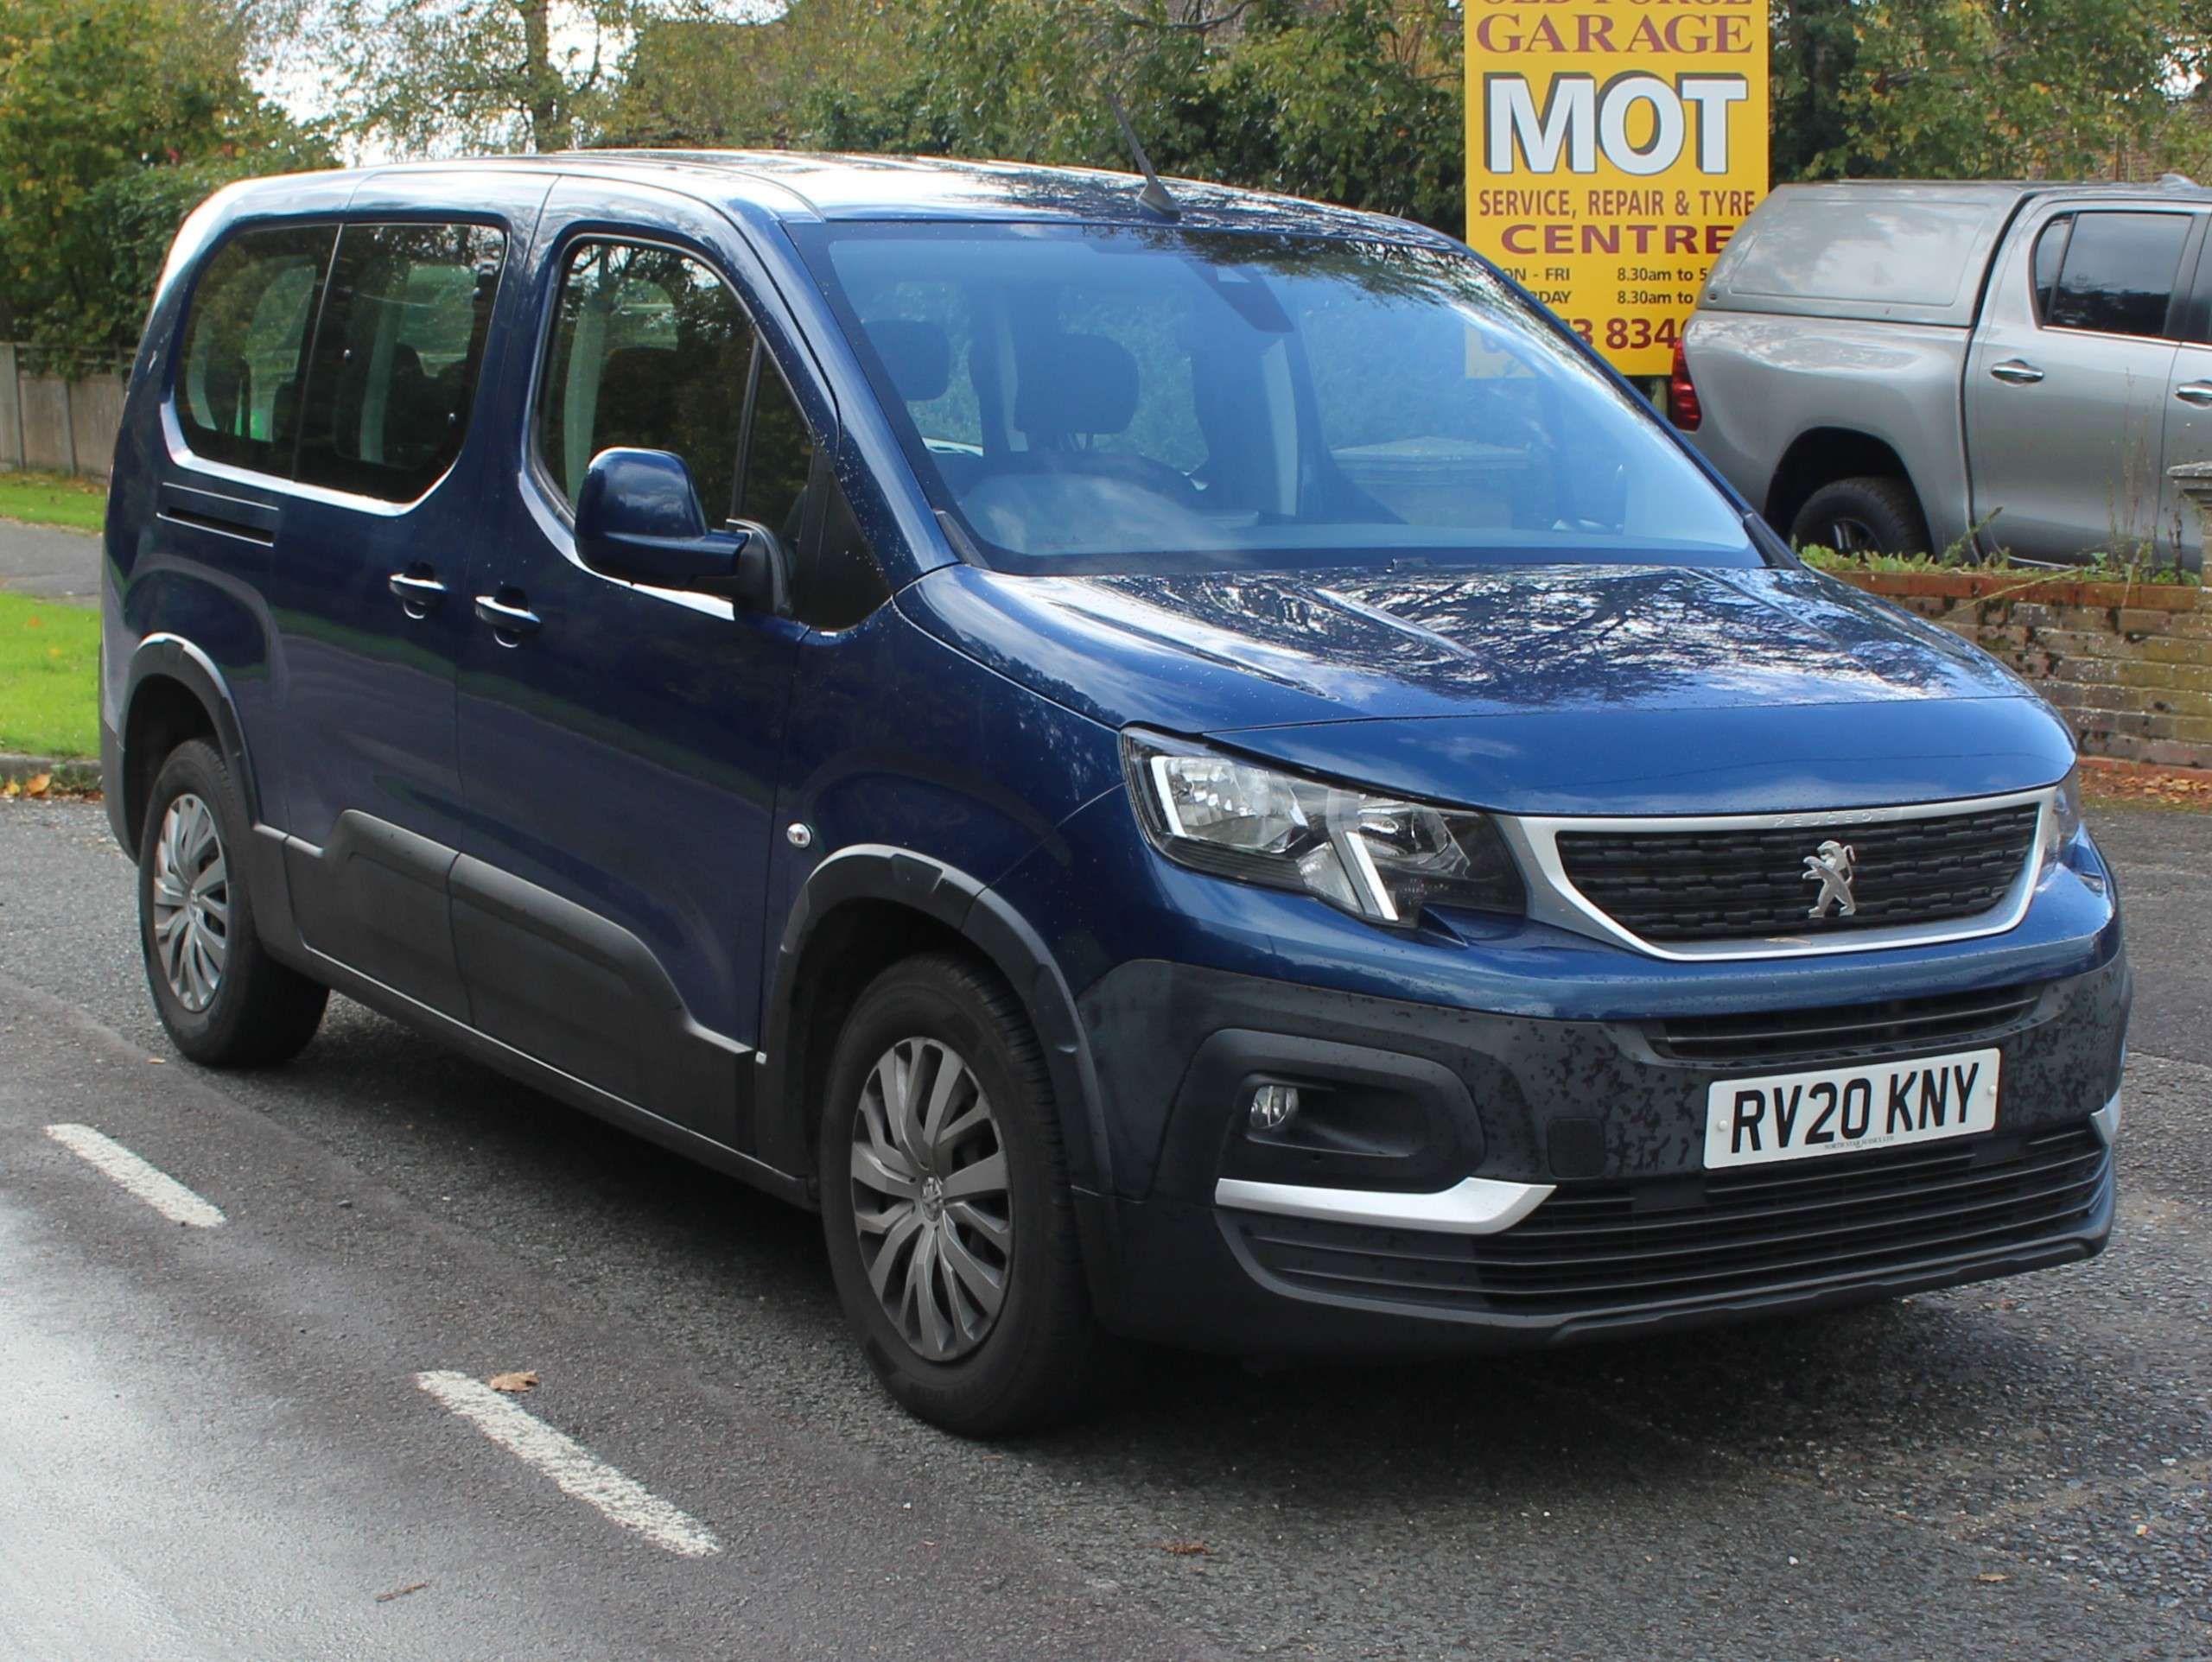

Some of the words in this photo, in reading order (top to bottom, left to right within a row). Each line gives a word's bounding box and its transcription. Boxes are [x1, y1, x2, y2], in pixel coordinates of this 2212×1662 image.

[1476, 13, 1754, 54] GARAGE
[1483, 70, 1749, 175] MOT
[1479, 190, 1577, 219] SERVICE,
[1588, 190, 1664, 216] REPAIR
[1675, 190, 1690, 216] &
[1699, 190, 1756, 216] TYRE
[1500, 225, 1734, 255] CENTRE
[1545, 267, 1570, 282] FRI
[1617, 267, 1672, 282] 8.30am
[1677, 268, 1694, 282] to
[1617, 290, 1672, 304] 8.30am
[1677, 291, 1694, 304] to
[1605, 317, 1688, 350] 834
[1774, 809, 1889, 828] PEUGEOT
[1731, 1077, 1872, 1154] RV20
[1886, 1062, 1980, 1135] KNY
